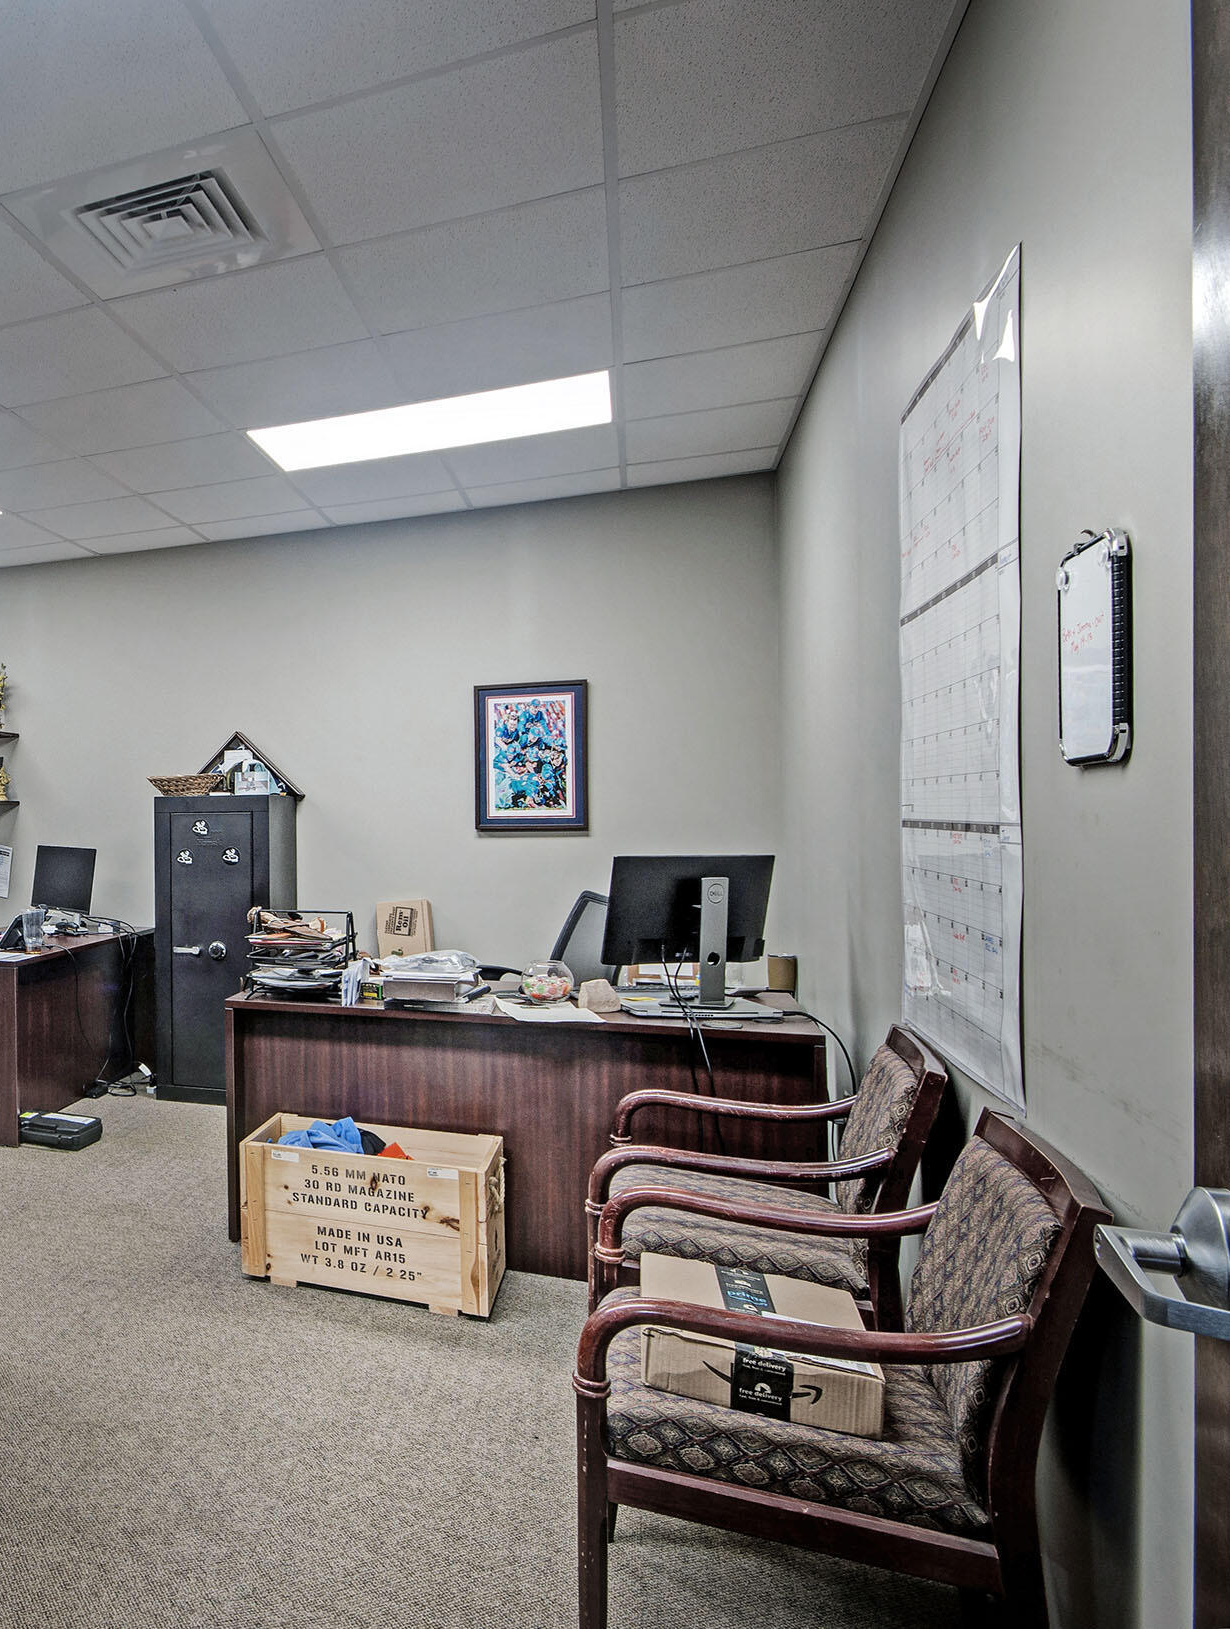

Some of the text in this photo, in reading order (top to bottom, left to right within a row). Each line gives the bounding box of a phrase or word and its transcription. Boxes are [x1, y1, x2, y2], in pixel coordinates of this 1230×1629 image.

[311, 1164, 406, 1185] 5.56 MM NATO
[304, 1179, 415, 1202] 30 RD MAGAZINE
[292, 1192, 428, 1219] STANDARD CAPACITY
[317, 1226, 403, 1248] MADE IN USA
[300, 1253, 318, 1264] WT
[324, 1257, 344, 1269] 3.8
[351, 1261, 367, 1273] OZ
[315, 1241, 406, 1264] LOT MFT AR15
[743, 1357, 756, 1366] free
[758, 1361, 786, 1372] delivery
[739, 1387, 753, 1395] free
[754, 1391, 782, 1402] delivery
